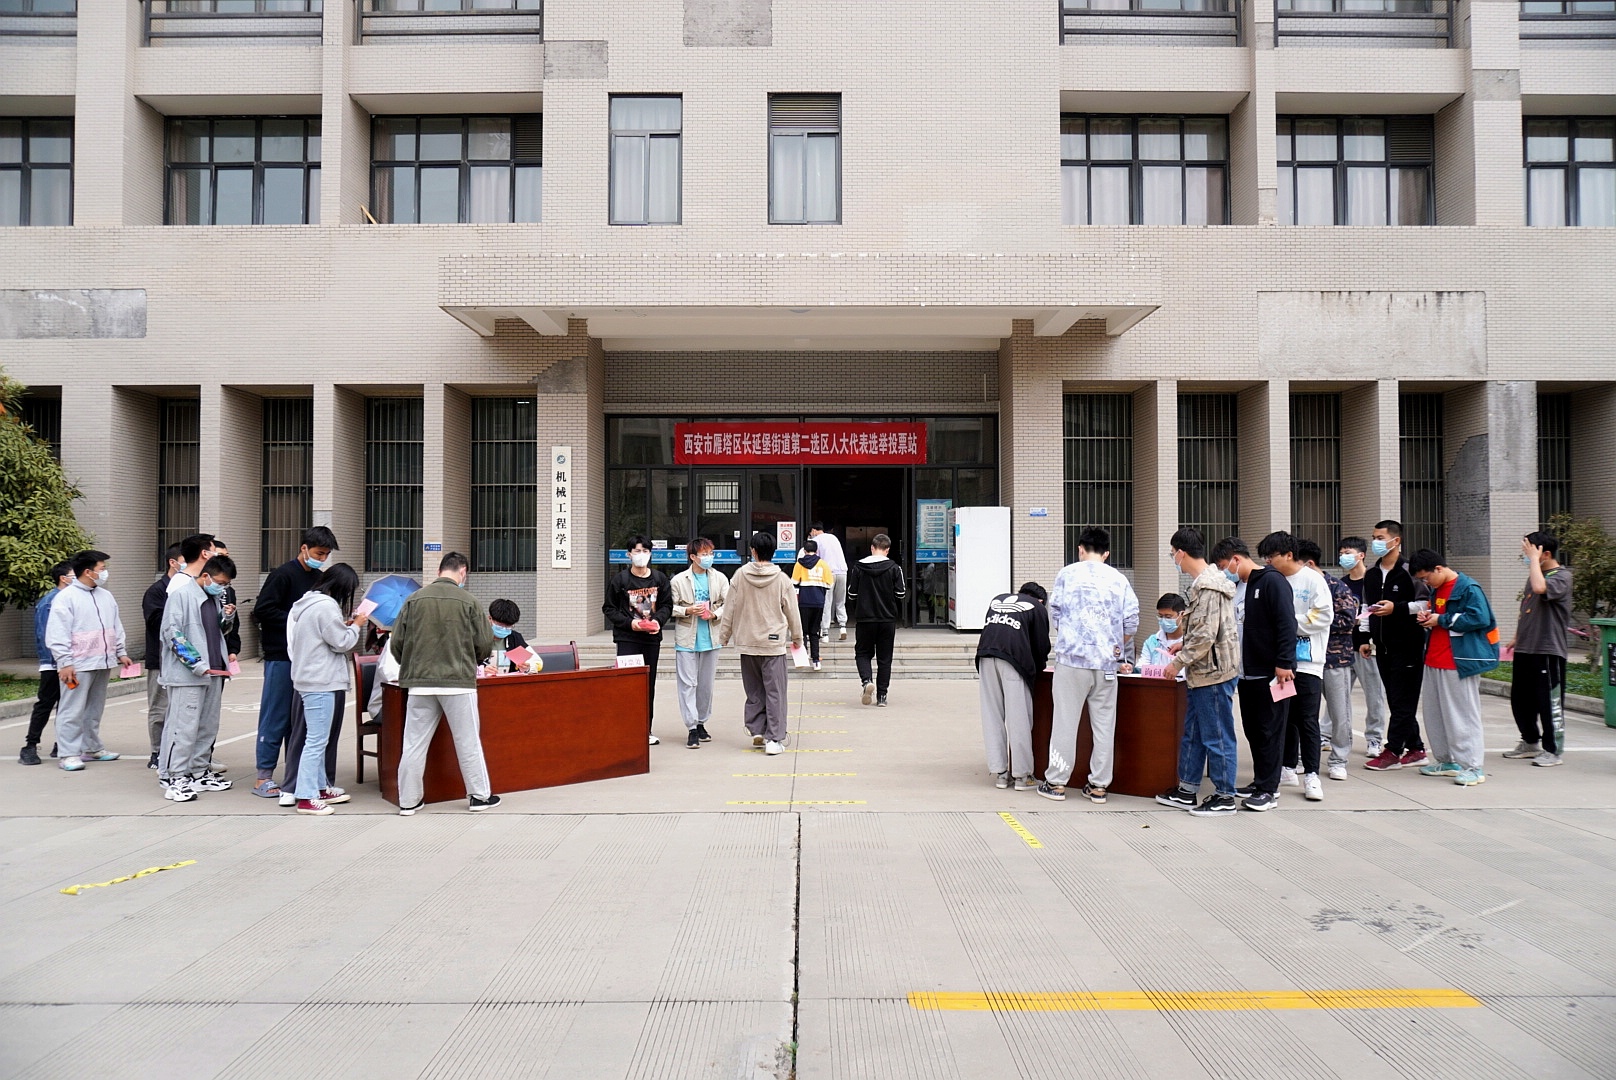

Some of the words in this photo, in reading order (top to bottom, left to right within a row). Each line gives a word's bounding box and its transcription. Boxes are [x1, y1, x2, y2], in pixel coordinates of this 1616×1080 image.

[684, 432, 918, 455] 西安市雁塔区长延堡街道第二选区人大代表选举投票站
[555, 470, 567, 561] 机械工程学院
[1144, 667, 1167, 678] 询问
